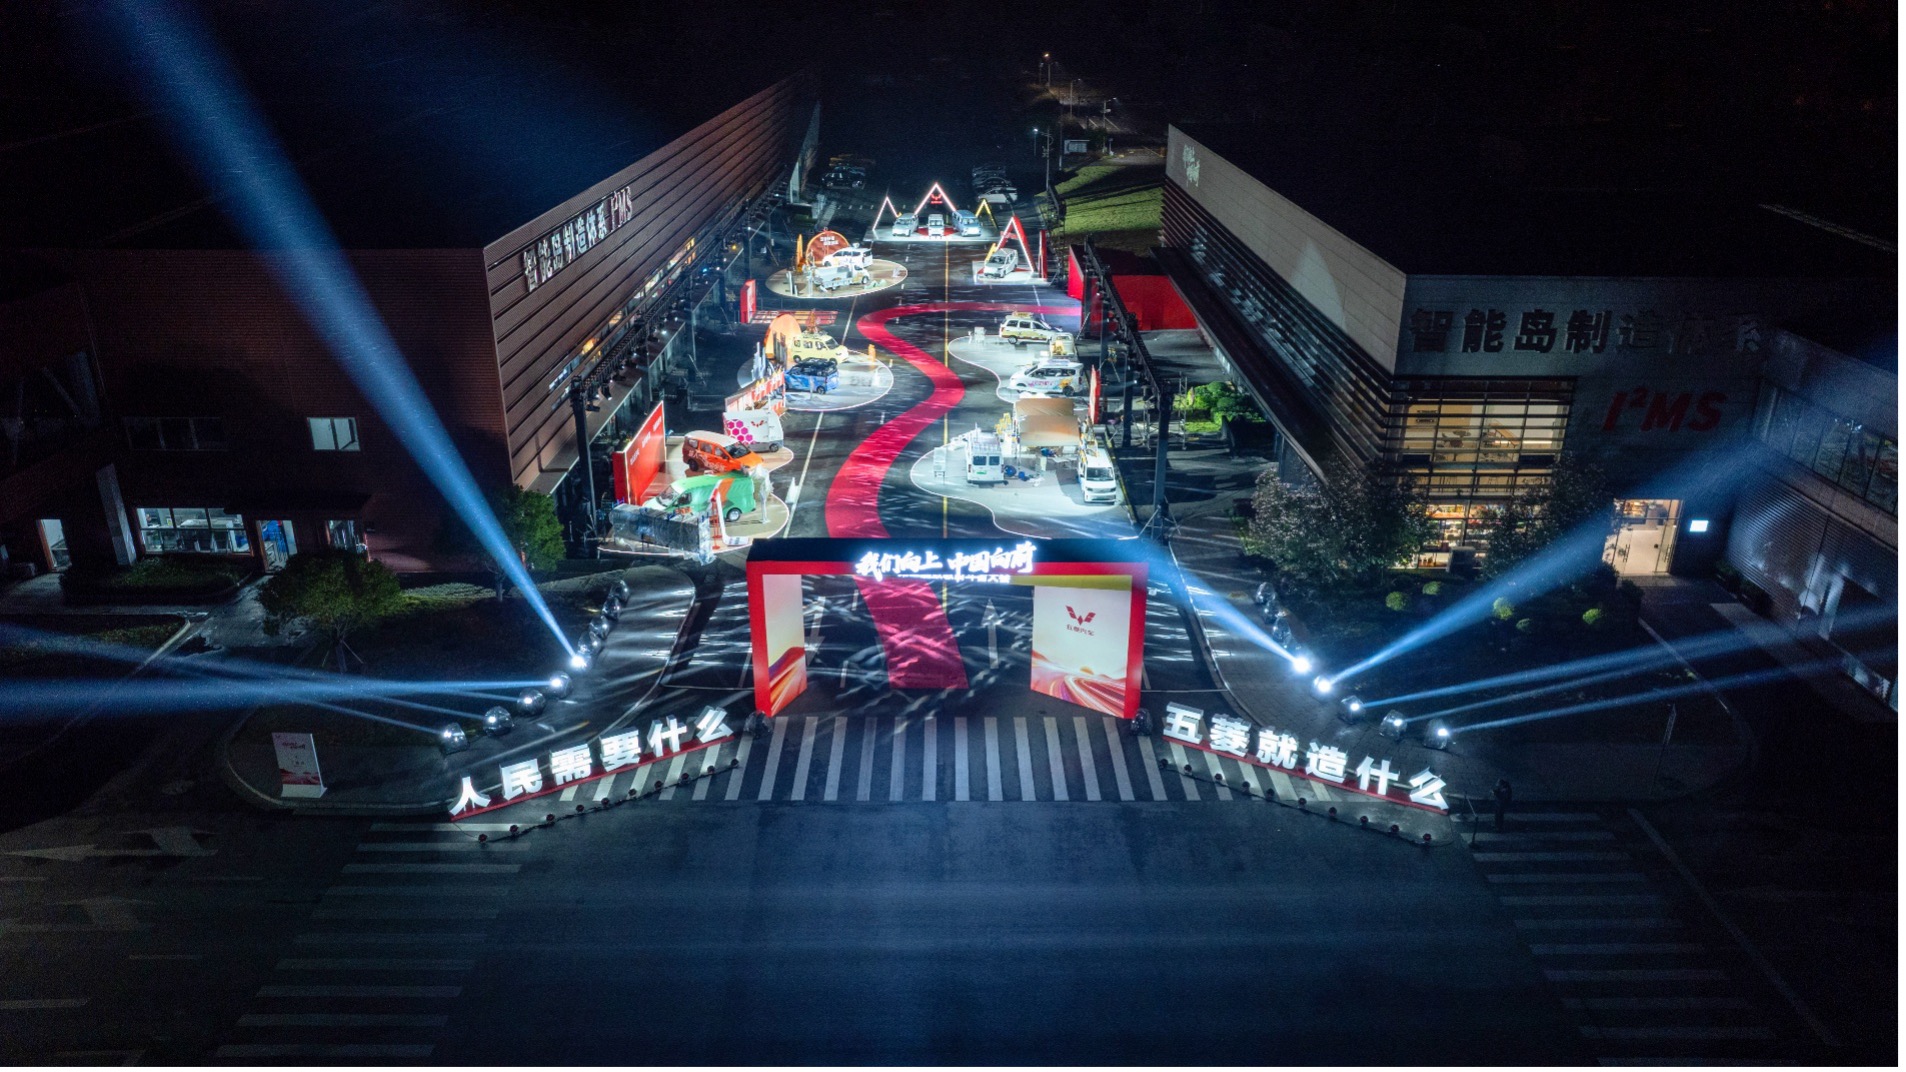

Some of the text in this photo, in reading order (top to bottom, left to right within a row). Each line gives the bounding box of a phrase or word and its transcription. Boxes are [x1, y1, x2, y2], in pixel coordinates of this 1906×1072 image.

[523, 203, 608, 292] 智能岛制造体系
[855, 541, 1037, 582] 我们向上 中国向前
[449, 705, 734, 816] 人民需要什么
[1163, 701, 1449, 811] 五菱就造什么
